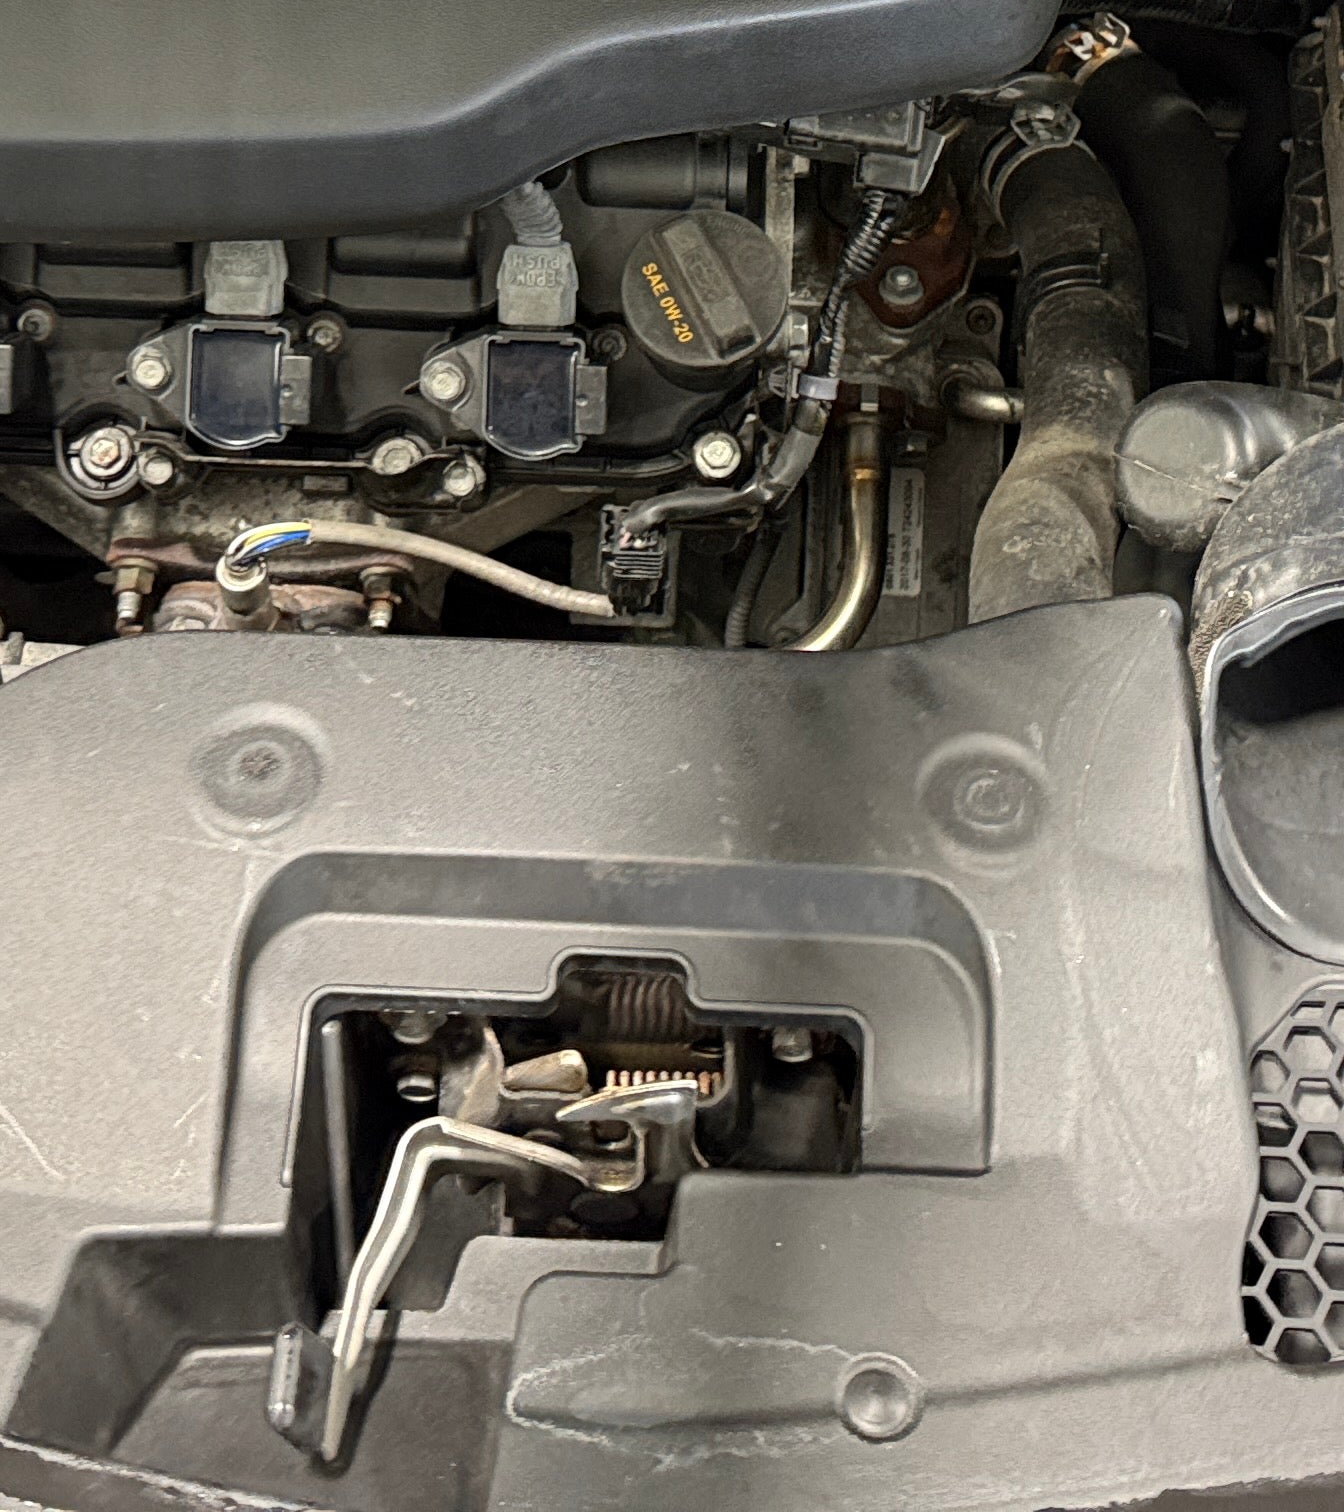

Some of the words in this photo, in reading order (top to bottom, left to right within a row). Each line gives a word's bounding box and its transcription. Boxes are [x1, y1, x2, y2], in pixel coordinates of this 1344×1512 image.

[513, 254, 560, 269] PUSH
[642, 262, 670, 297] SAE
[659, 297, 694, 344] 0W-20
